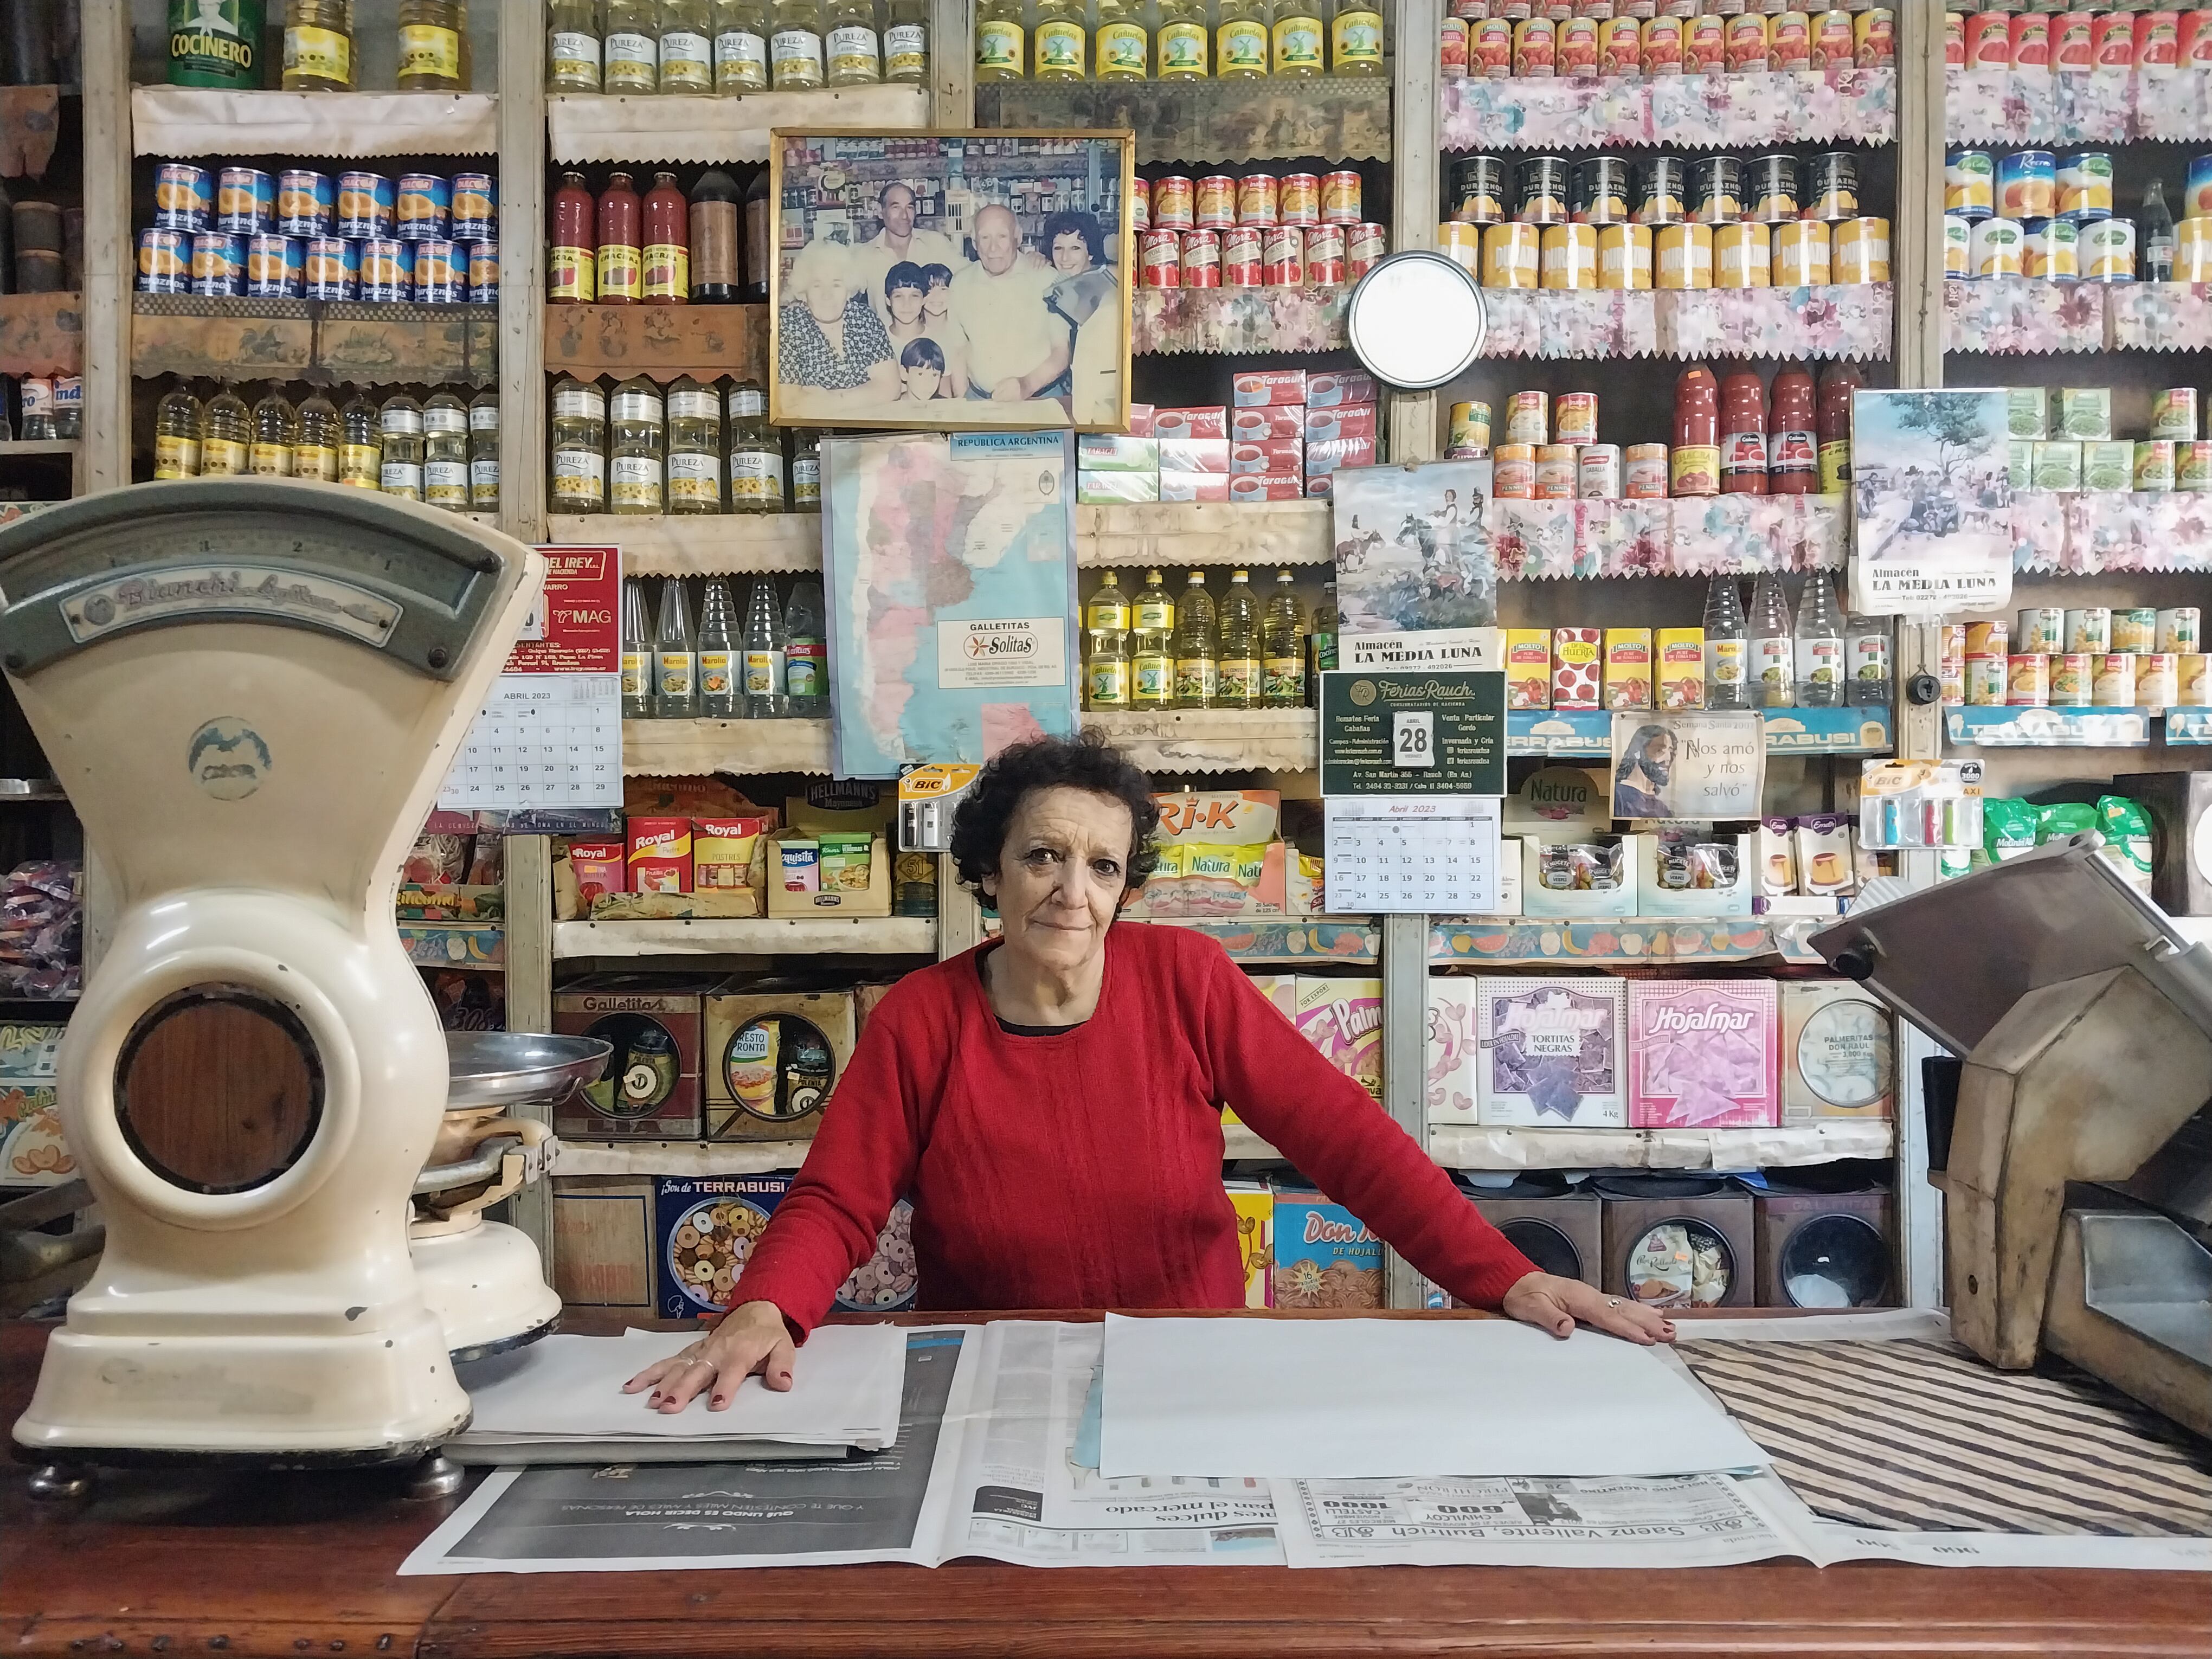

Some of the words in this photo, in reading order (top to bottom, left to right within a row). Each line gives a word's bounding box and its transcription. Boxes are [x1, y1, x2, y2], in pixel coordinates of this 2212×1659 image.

[610, 38, 643, 49] PUREZA
[833, 33, 867, 43] PUREZA
[171, 34, 253, 69] COCINERO
[1144, 233, 1170, 249] Mora
[1308, 230, 1335, 245] Mora
[1008, 435, 1059, 446] ARGENTINA
[556, 454, 589, 465] PUREZA
[427, 466, 454, 474] PUREZA
[616, 461, 650, 472] PUREZA
[564, 557, 593, 568] IREY
[1873, 568, 1919, 578] Almacén
[1873, 580, 1891, 590] LA
[1899, 579, 1950, 590] MEDIA
[1957, 578, 1996, 589] LUNA
[573, 610, 612, 623] MAG
[970, 622, 1030, 631] GALLETITAS
[1355, 640, 1403, 651] Almacén
[1355, 653, 1374, 663] LA
[1381, 650, 1434, 662] MEDIA
[1441, 646, 1482, 659] LUNA
[1562, 647, 1595, 658] HUERTA
[664, 657, 688, 665] Marolio
[1379, 680, 1425, 698] Ferias
[1424, 680, 1471, 699] Rauch
[1673, 721, 1707, 730] Semana
[1708, 720, 1731, 729] Santa
[1399, 728, 1427, 753] 28
[1723, 743, 1754, 755] amó
[1703, 764, 1714, 779] y
[1720, 763, 1745, 774] nos
[1531, 779, 1587, 802] Natura
[706, 824, 741, 837] Royal
[635, 829, 674, 850] Royal
[574, 847, 606, 859] Royal
[907, 860, 923, 874] 51
[1193, 856, 1230, 872] Natura
[1301, 998, 1310, 1006] FOR
[1311, 985, 1329, 1001] EXPORT
[583, 996, 667, 1012] Galletitas
[1649, 1004, 1755, 1034] Hojalmar
[1824, 1034, 1873, 1043] PALMERITAS
[1609, 1110, 1618, 1118] Kg
[681, 1181, 691, 1192] de
[692, 1181, 785, 1193] TERRABUSI
[1305, 1211, 1356, 1243] Don
[1333, 1248, 1344, 1256] DE
[1303, 1272, 1313, 1280] 16
[1106, 1502, 1203, 1514] mercado
[1437, 1505, 1504, 1513] 600
[1156, 1512, 1228, 1522] dulces
[1391, 1527, 1485, 1538] Bullrich
[1609, 1527, 1685, 1536] Saenz
